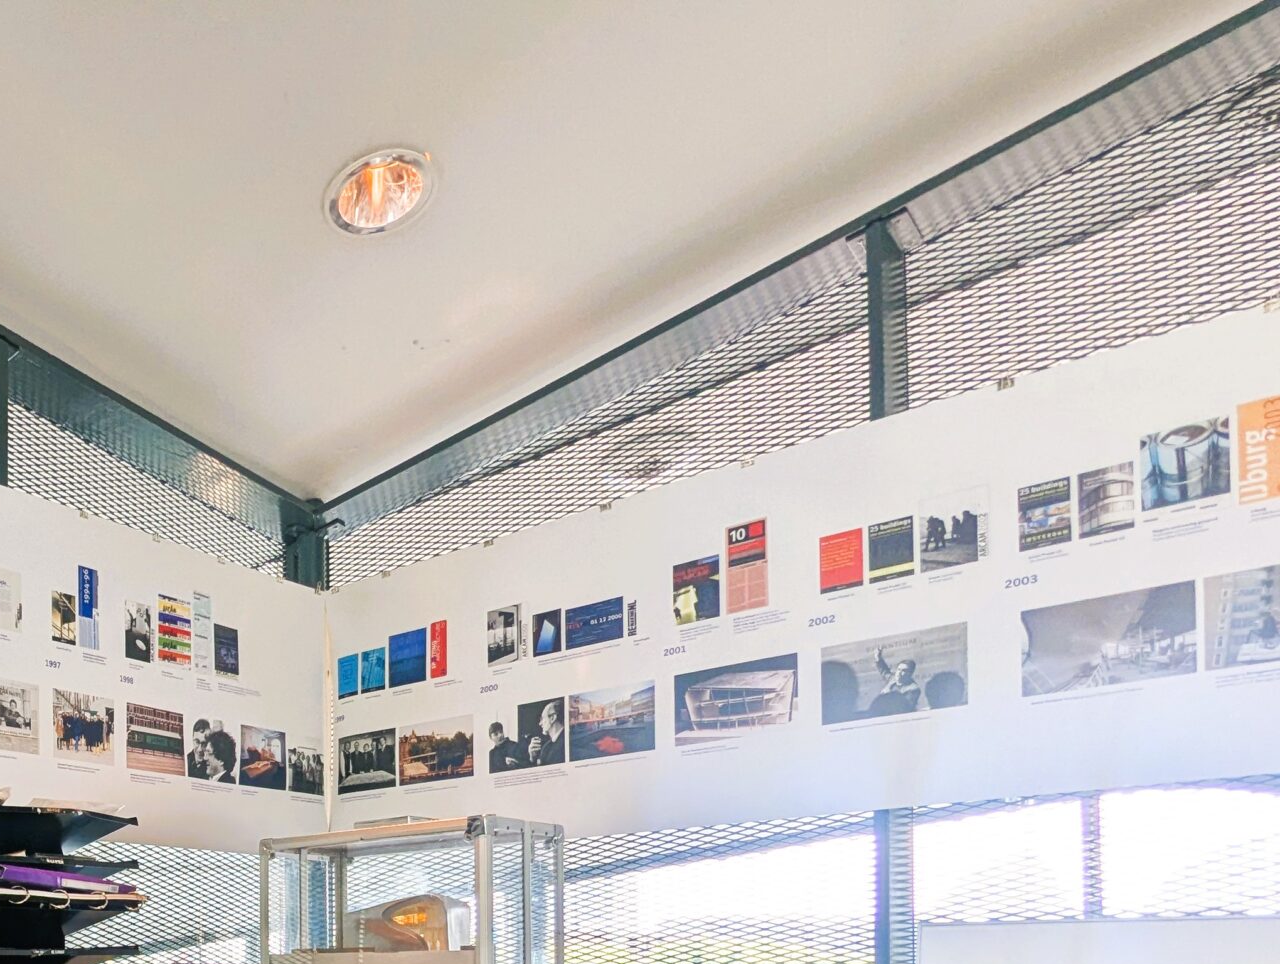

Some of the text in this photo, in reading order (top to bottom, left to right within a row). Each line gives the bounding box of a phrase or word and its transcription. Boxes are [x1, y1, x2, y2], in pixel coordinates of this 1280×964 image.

[730, 528, 746, 542] 10
[83, 569, 91, 604] 1994-96
[1005, 574, 1039, 588] 2003
[808, 615, 836, 627] 2002
[663, 646, 687, 657] 2001
[45, 659, 61, 669] 1997
[480, 684, 499, 694] 2000
